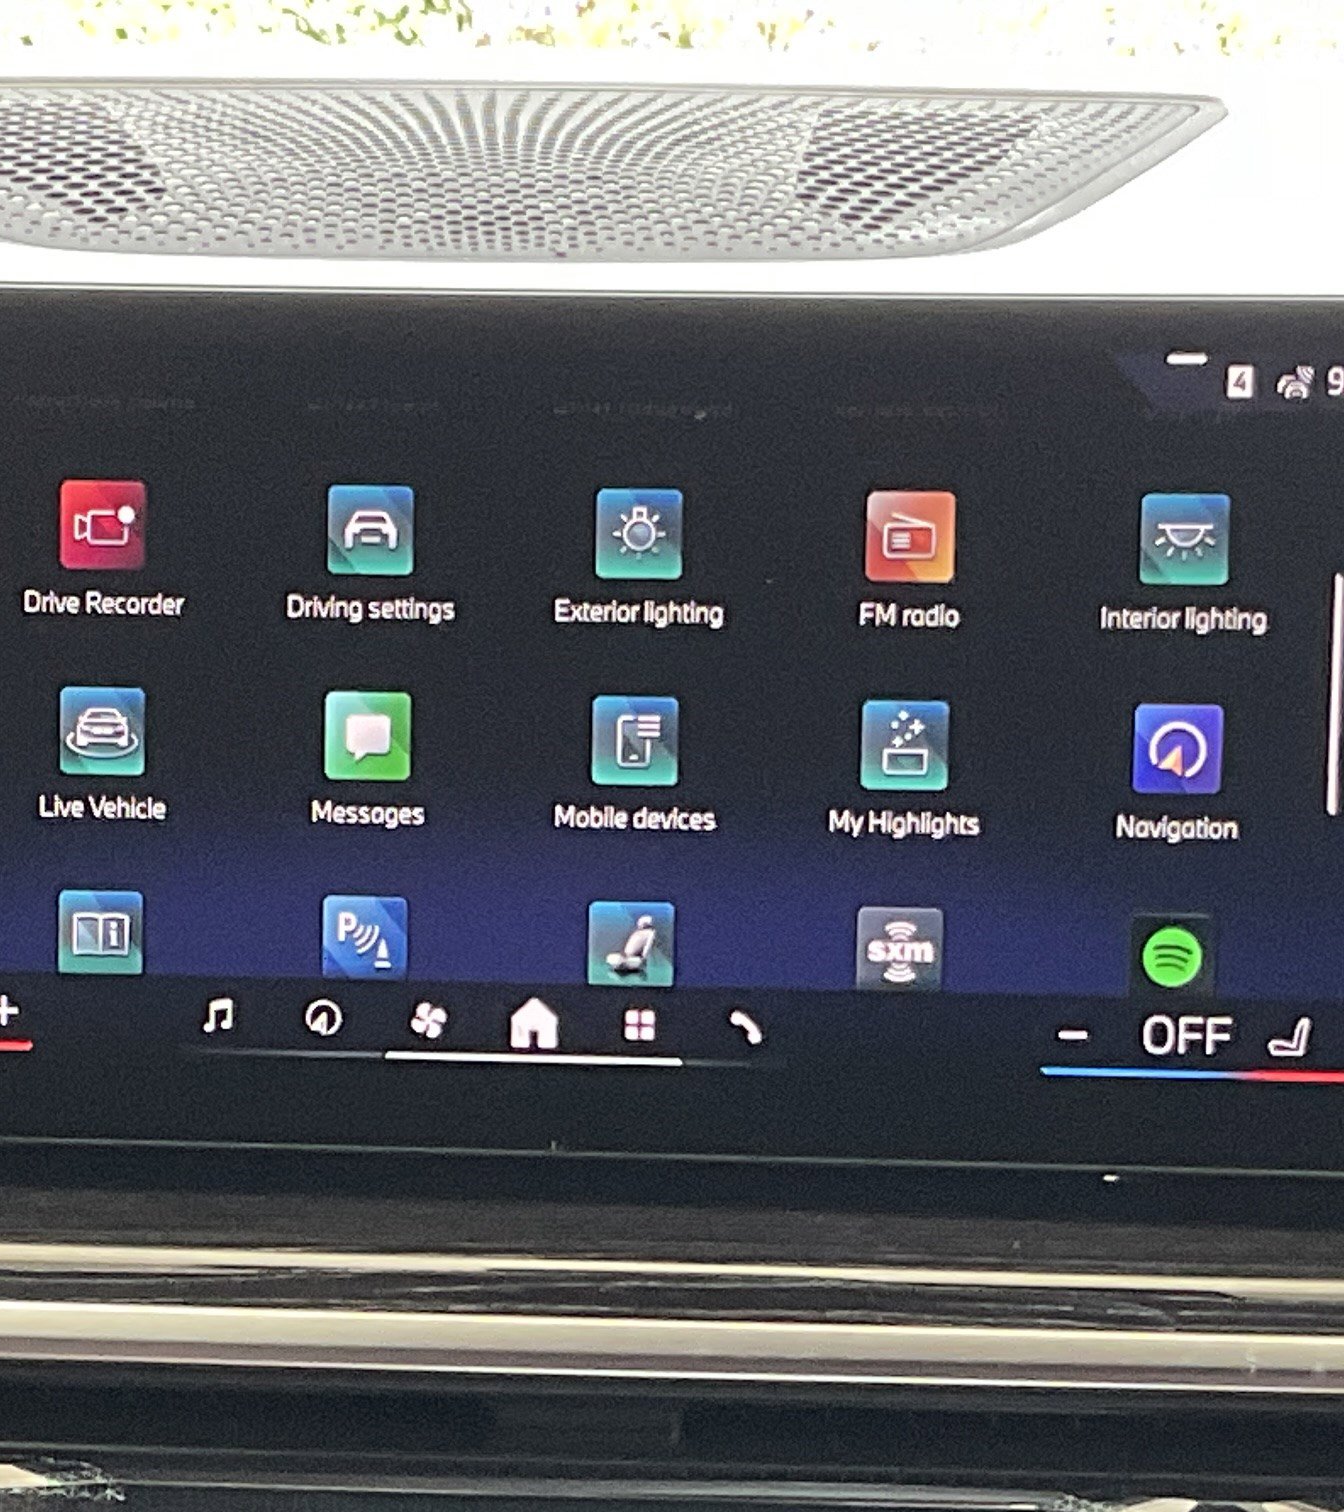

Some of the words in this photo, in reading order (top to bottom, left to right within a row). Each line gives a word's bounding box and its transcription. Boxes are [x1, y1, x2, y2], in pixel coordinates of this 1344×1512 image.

[22, 589, 81, 614] Drive
[84, 590, 186, 617] Recorder
[286, 594, 364, 622] Driving
[367, 595, 456, 625] settings
[553, 598, 640, 624] Exterior
[643, 600, 725, 630] lighting
[858, 602, 897, 626] FM
[901, 603, 962, 628] radio
[1100, 606, 1181, 630] Interior
[1184, 606, 1269, 636] lighting
[38, 795, 85, 820] Live
[89, 796, 167, 822] Vehicle
[310, 800, 426, 829] Messages
[553, 805, 629, 830] Mobile
[633, 806, 718, 832] devices
[828, 810, 865, 838] My
[867, 811, 981, 839] Highlights
[1115, 814, 1240, 844] Navigation
[866, 938, 935, 964] sxm
[1141, 1015, 1234, 1056] OFF
